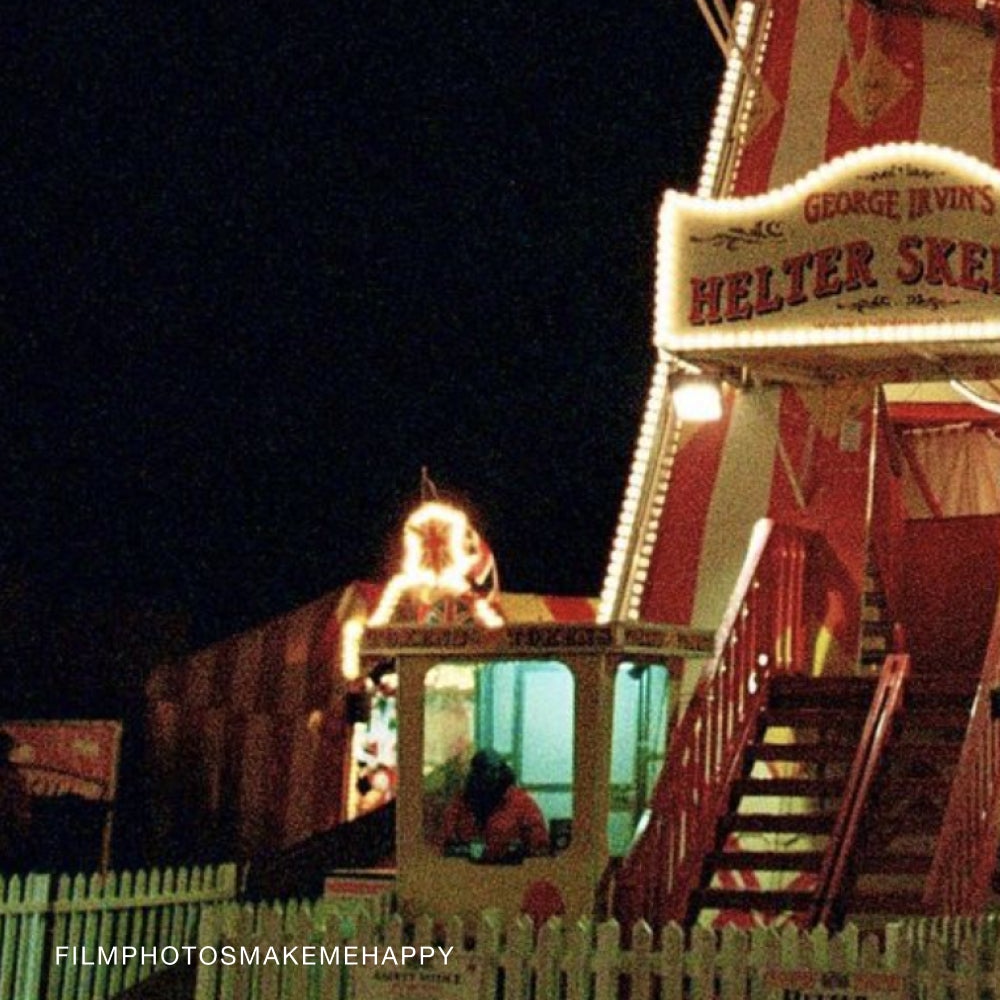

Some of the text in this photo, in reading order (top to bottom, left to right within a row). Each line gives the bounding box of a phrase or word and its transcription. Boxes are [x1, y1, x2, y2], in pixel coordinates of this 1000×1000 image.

[804, 186, 995, 224] GEORGE IRVIN'S
[690, 240, 878, 324] HELTER
